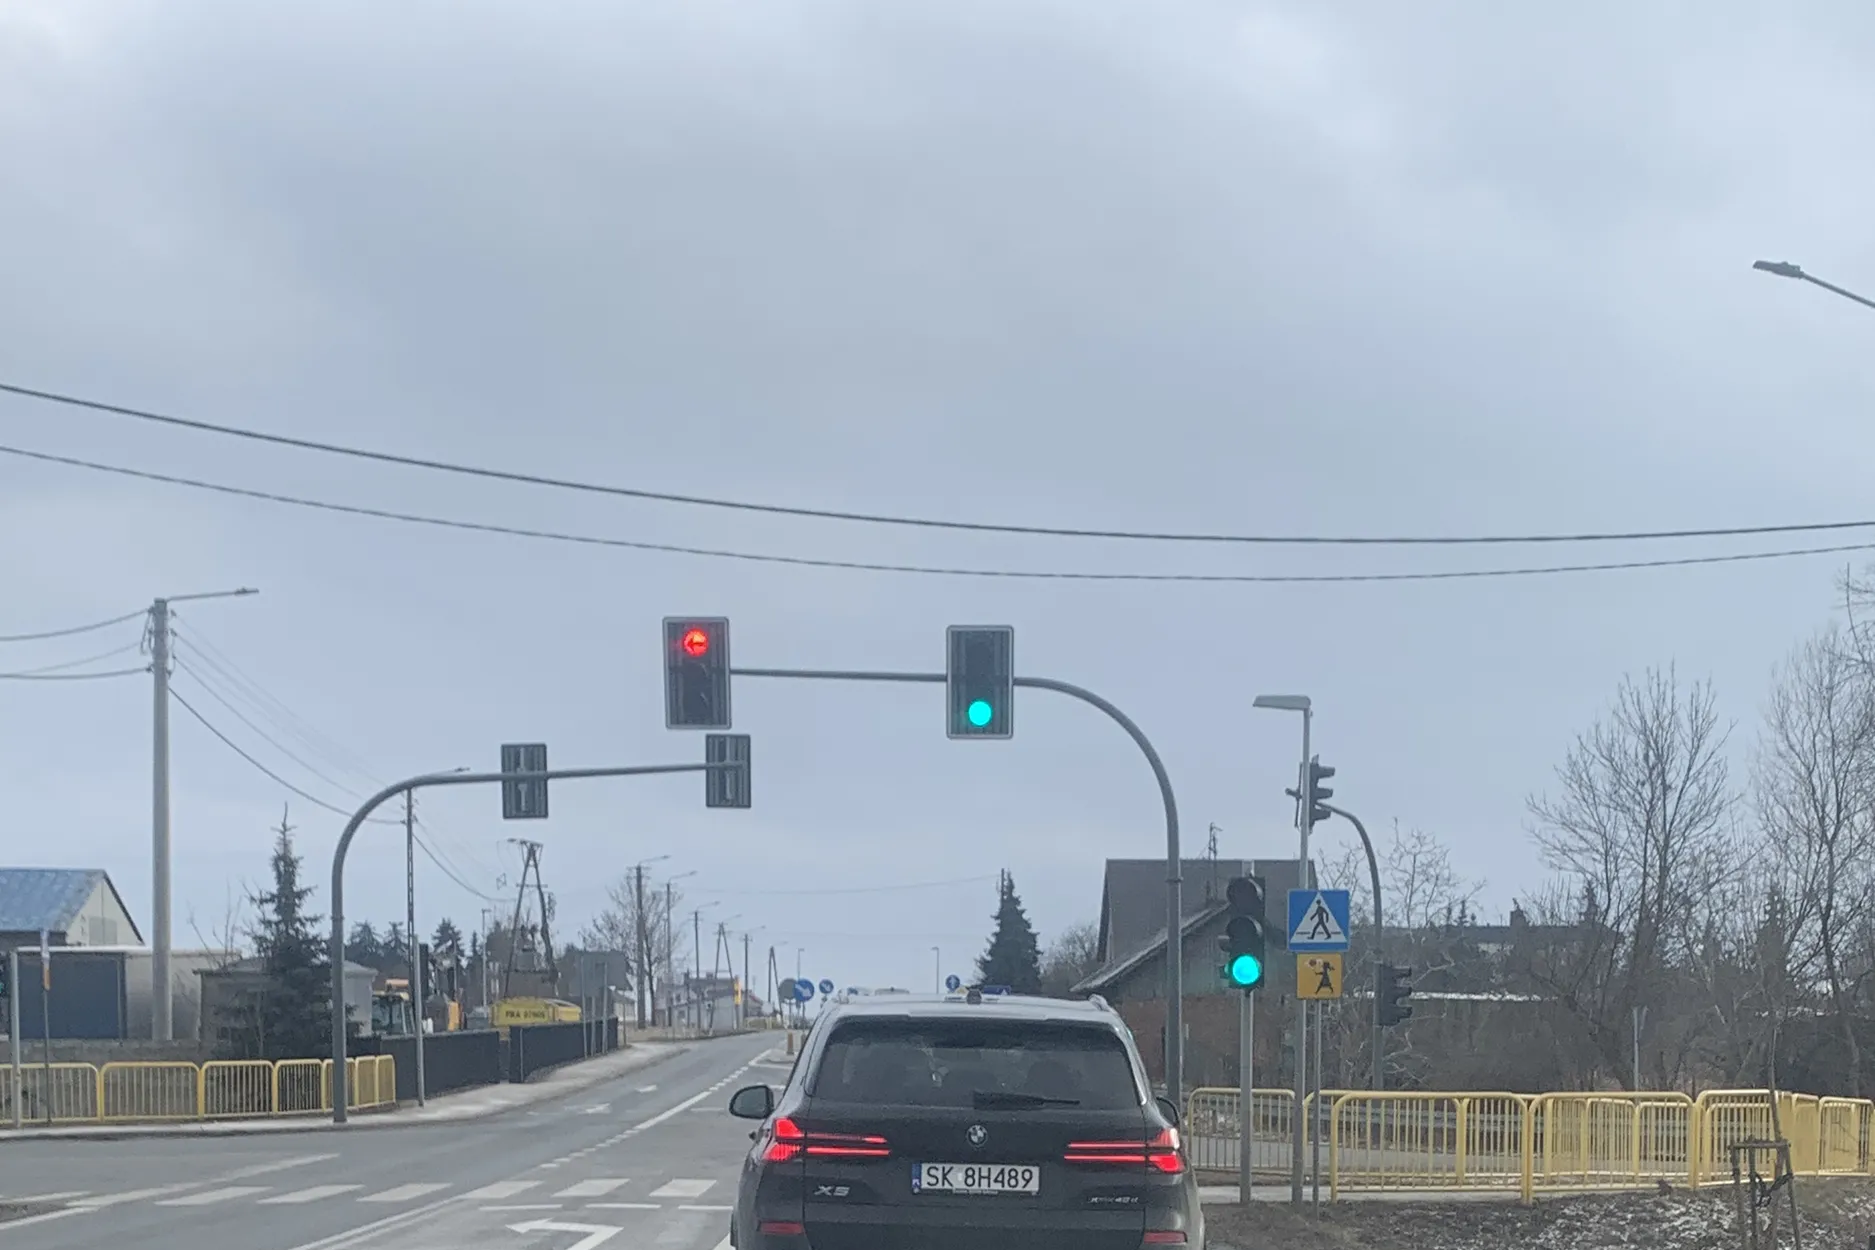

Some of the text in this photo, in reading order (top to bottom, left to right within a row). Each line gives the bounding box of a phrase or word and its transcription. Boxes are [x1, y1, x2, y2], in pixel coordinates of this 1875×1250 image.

[926, 1166, 954, 1187] SK
[964, 1166, 1034, 1189] 8H489
[813, 1185, 851, 1197] X5
